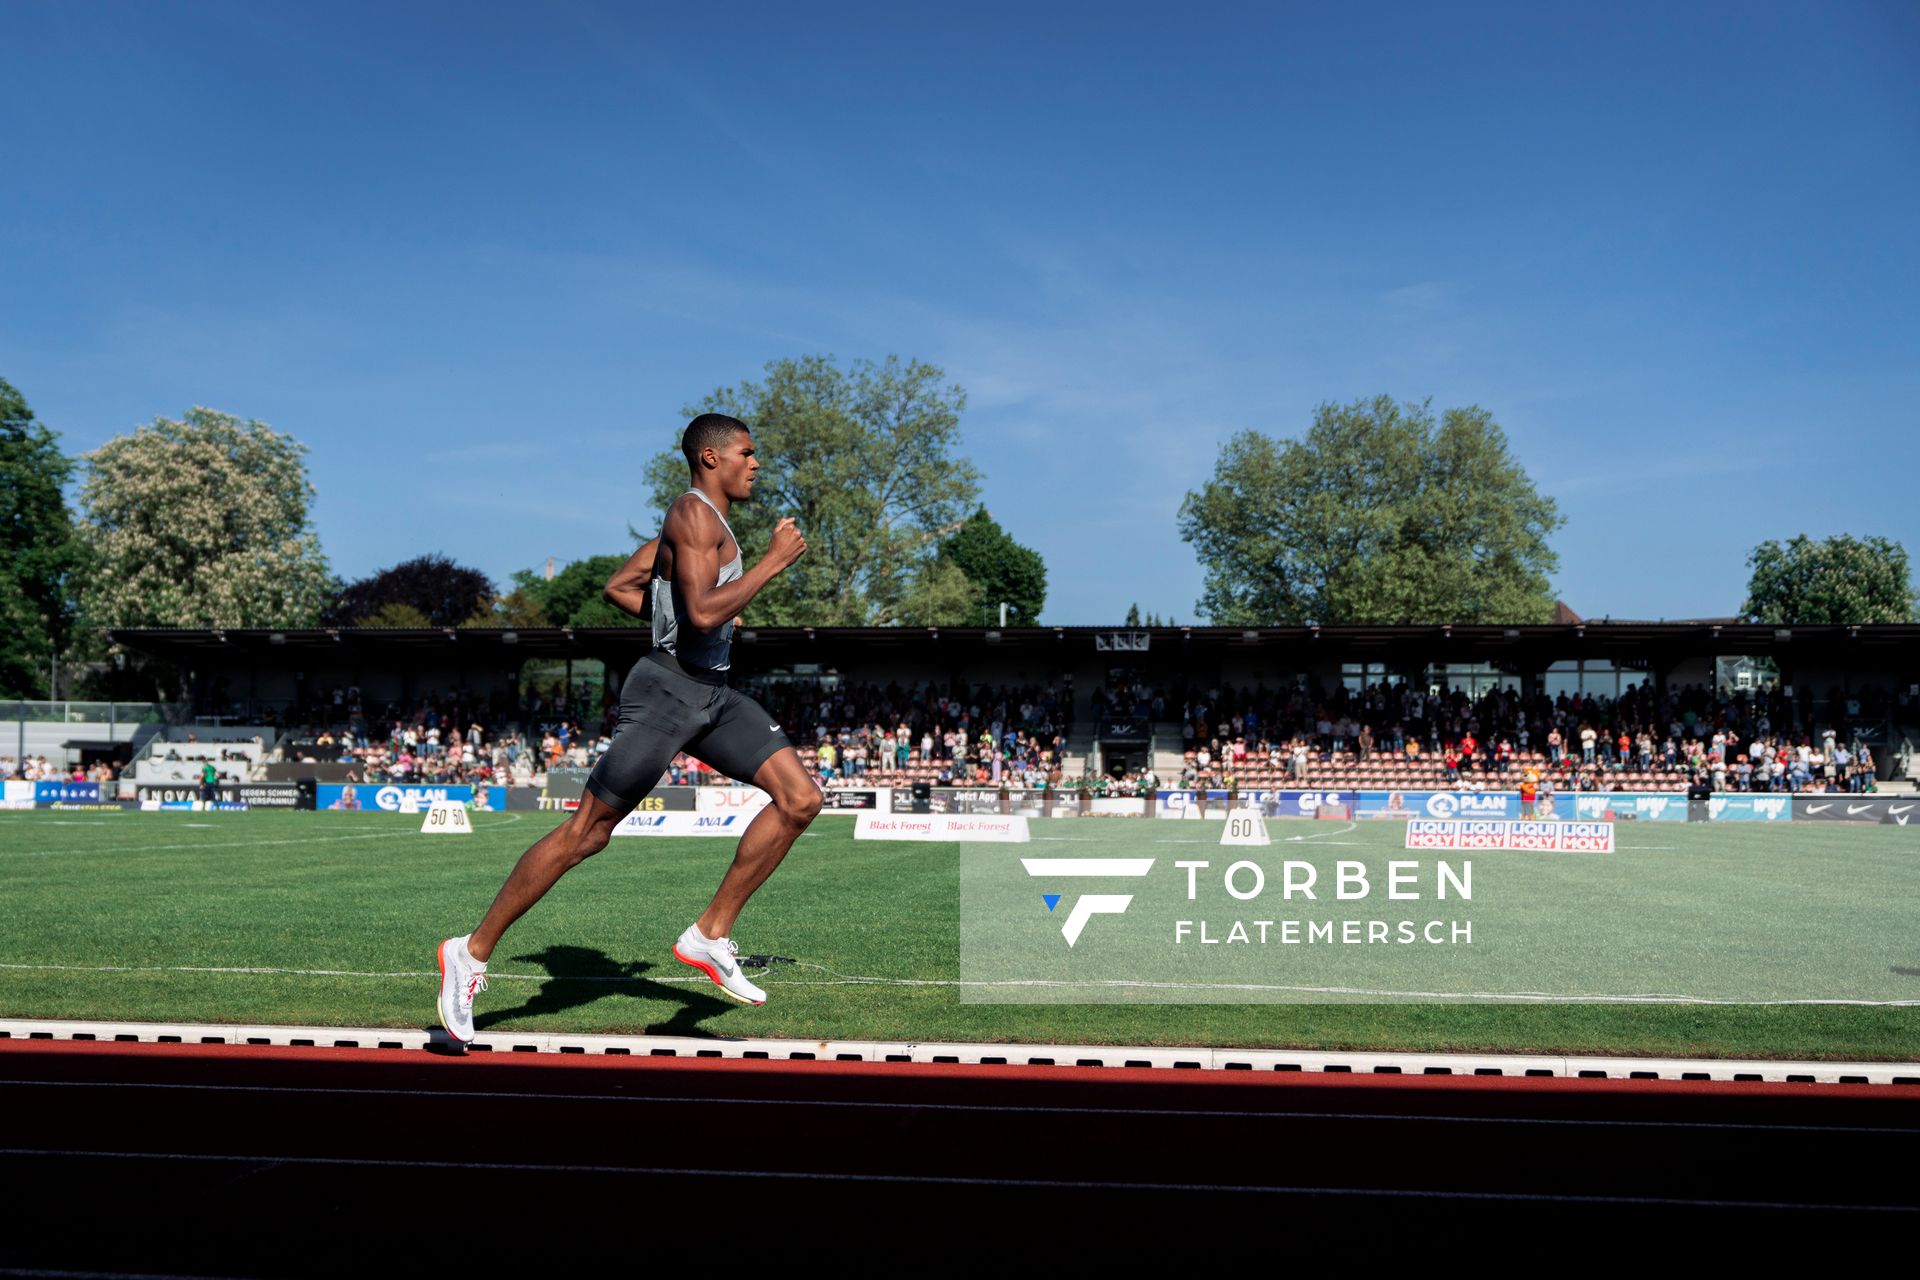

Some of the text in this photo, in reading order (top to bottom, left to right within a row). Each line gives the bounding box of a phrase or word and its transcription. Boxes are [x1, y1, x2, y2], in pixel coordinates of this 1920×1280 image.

[151, 789, 234, 802] NOVAN
[978, 791, 997, 803] App
[1460, 795, 1506, 809] PLAN
[638, 797, 664, 810] ES
[430, 808, 465, 825] 50 50
[626, 816, 652, 826] ANA
[694, 817, 721, 826] ANA
[869, 820, 932, 833] Black Forest
[947, 821, 1010, 832] Black Forest
[1231, 818, 1252, 838] 60
[1411, 822, 1454, 835] LIQUI
[1461, 822, 1504, 835] LIQUI
[1511, 823, 1555, 836] LIQUI
[1562, 824, 1608, 837] LIQUI
[1409, 834, 1454, 847] MOLY
[1459, 834, 1504, 847] MOLY
[1509, 835, 1555, 848] MOLY
[1561, 837, 1608, 850] MOLY
